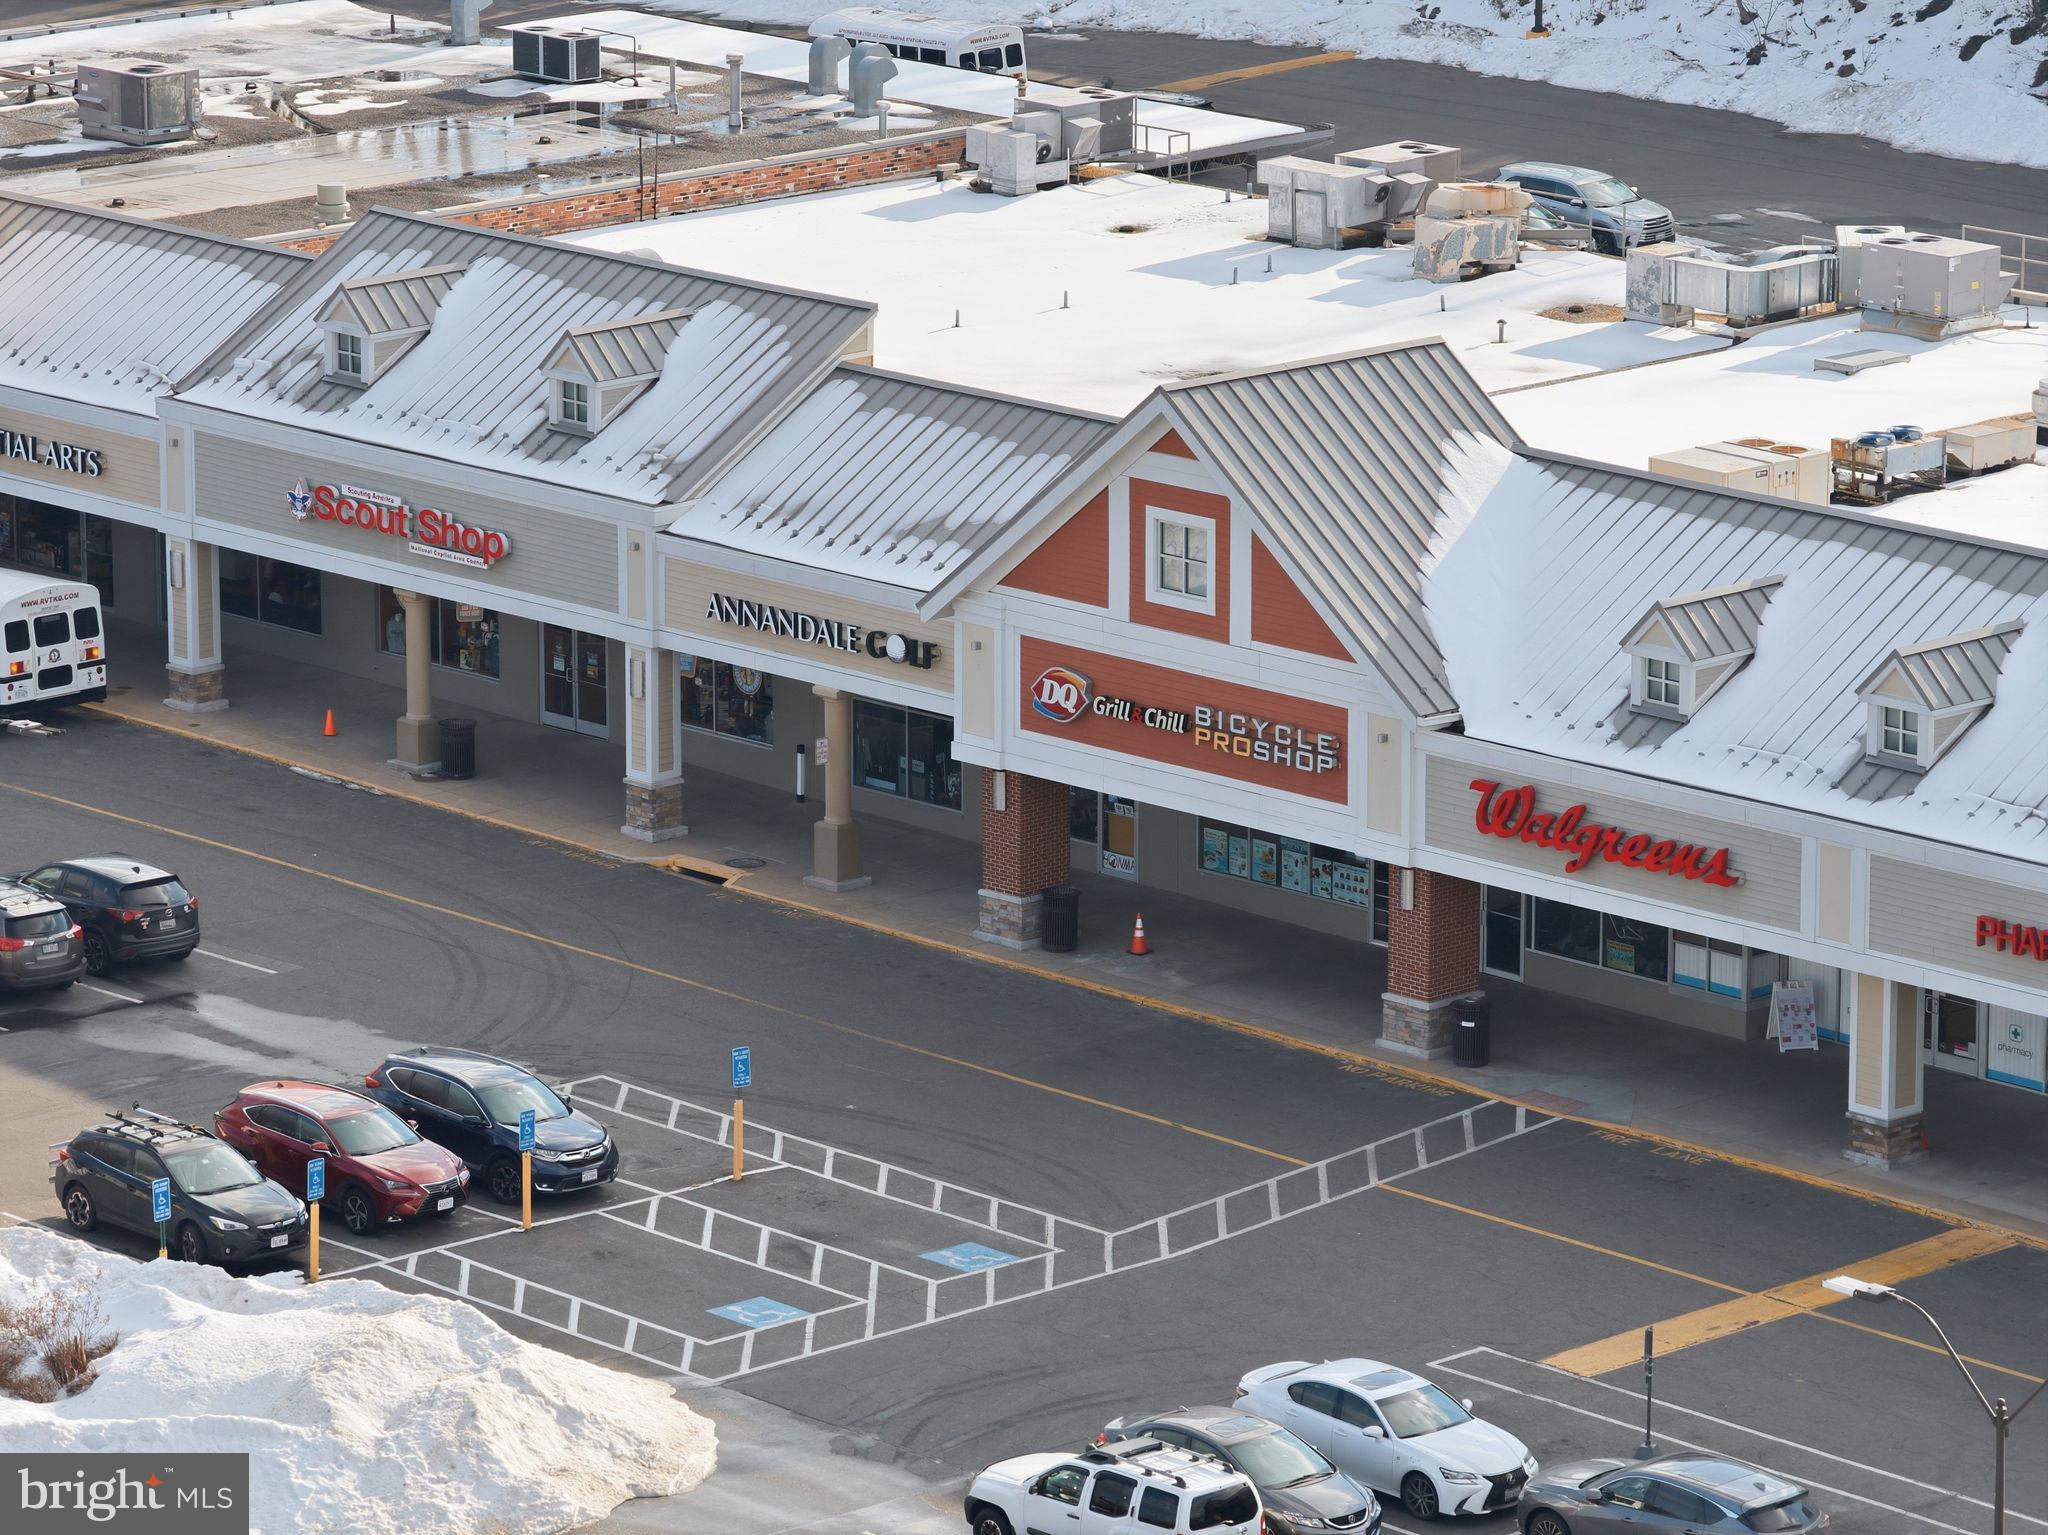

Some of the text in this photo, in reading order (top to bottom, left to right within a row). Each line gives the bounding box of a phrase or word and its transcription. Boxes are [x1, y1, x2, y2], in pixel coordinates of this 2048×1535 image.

[44, 441, 103, 477] ARTS
[314, 485, 510, 564] Scout Shop
[705, 593, 860, 654] ANNANDALE
[1041, 678, 1078, 714] DQ
[1195, 705, 1339, 756] BICYCLE
[1469, 778, 1740, 888] Walgreens
[1997, 1042, 2034, 1060] pharmacy
[1588, 1129, 1640, 1147] FIRE
